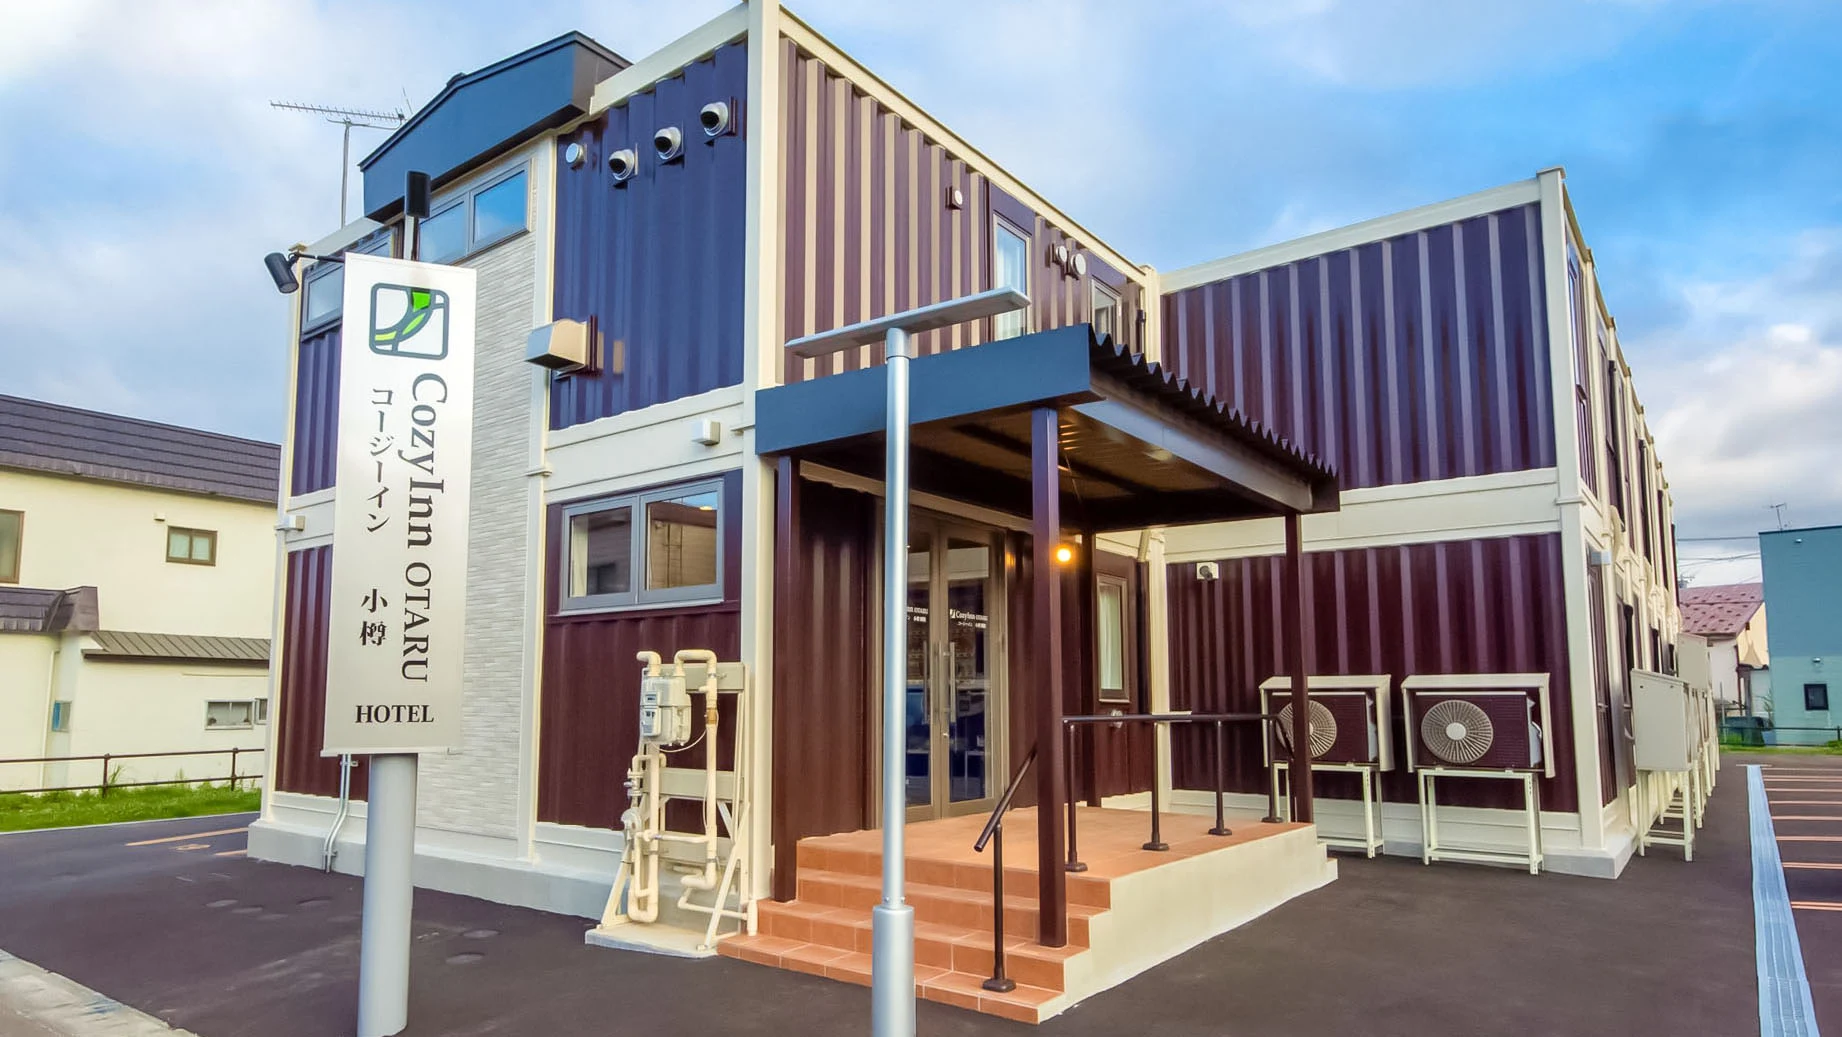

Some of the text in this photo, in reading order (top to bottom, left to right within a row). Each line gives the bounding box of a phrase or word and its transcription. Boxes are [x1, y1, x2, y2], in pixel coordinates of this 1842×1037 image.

[360, 388, 394, 646] コージーイン 小樽
[401, 562, 432, 682] OTARU
[355, 704, 434, 723] HOTEL
